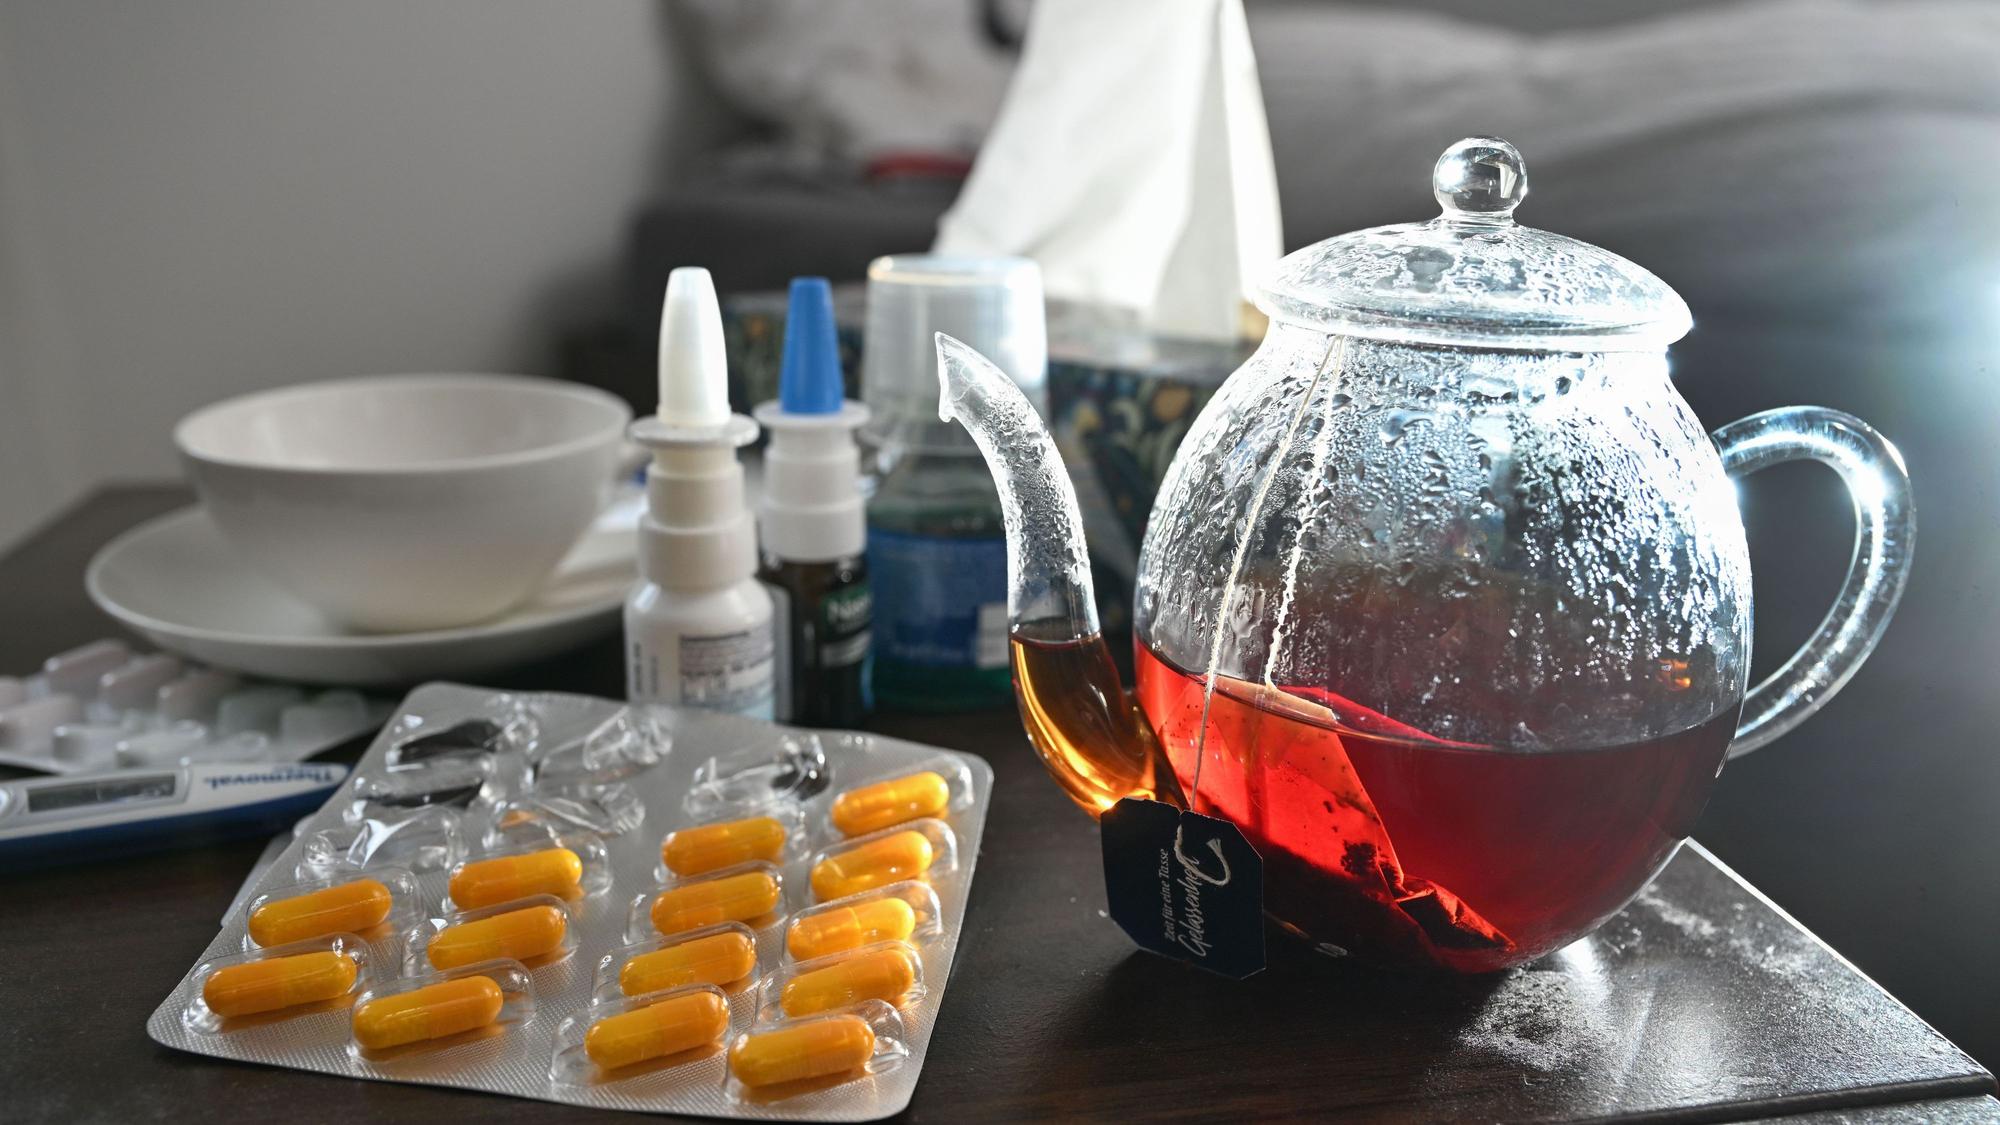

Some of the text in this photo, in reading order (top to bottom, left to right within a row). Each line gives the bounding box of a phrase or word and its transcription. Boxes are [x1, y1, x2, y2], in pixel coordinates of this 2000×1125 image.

[1158, 848, 1176, 941] Zeit für eine Tasse
[1177, 857, 1212, 956] Gelassenhet
